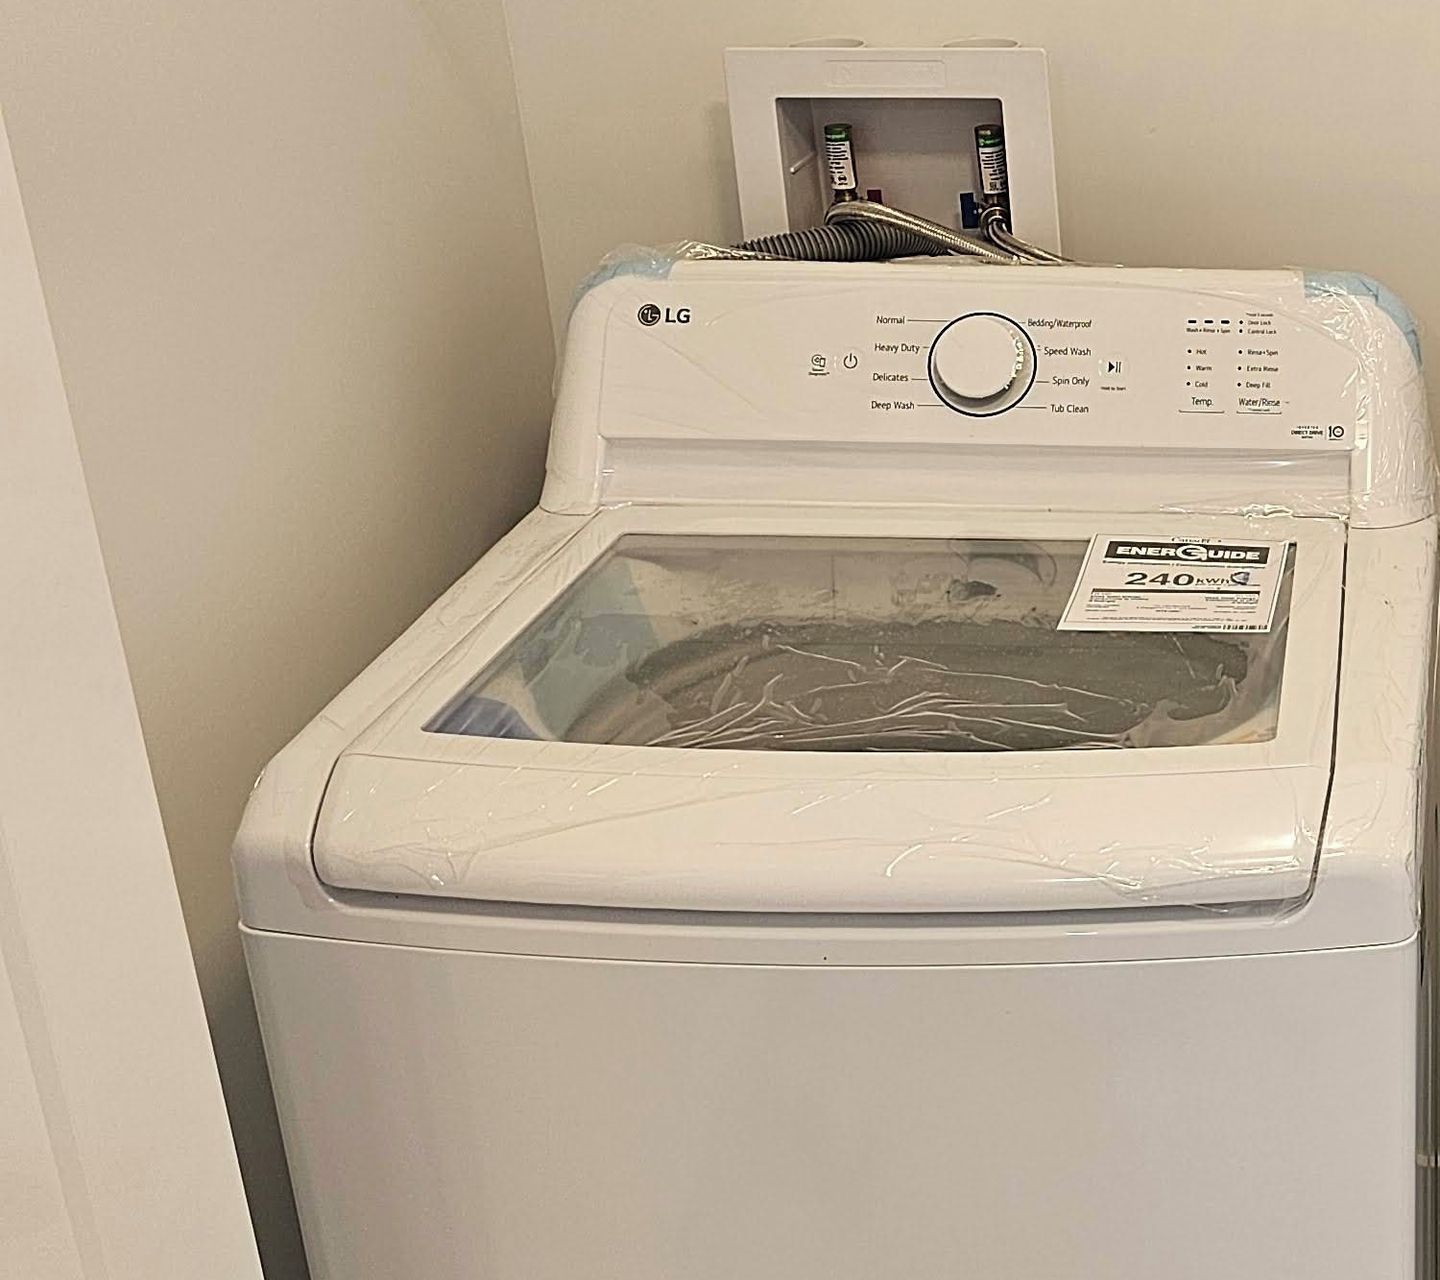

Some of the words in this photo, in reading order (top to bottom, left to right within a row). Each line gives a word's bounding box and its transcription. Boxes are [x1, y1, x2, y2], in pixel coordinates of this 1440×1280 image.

[665, 307, 691, 324] LG
[876, 315, 906, 324] Normal
[1027, 318, 1092, 330] Bedding/Waterproof
[874, 343, 899, 354] Heavy
[900, 343, 920, 354] Duty
[1044, 346, 1068, 357] Speed
[1070, 347, 1092, 356] Wash
[872, 372, 909, 382] Delicates
[1052, 376, 1070, 386] Spin
[1071, 376, 1090, 387] Only
[871, 401, 892, 410] Deep
[893, 401, 915, 410] Wash
[1191, 397, 1213, 407] Temp.
[1238, 397, 1281, 407] Water/Rinse
[1050, 404, 1064, 413] Tub
[1066, 404, 1089, 413] Clean
[1116, 544, 1261, 561] ENERGUIDE
[1124, 572, 1195, 586] 240
